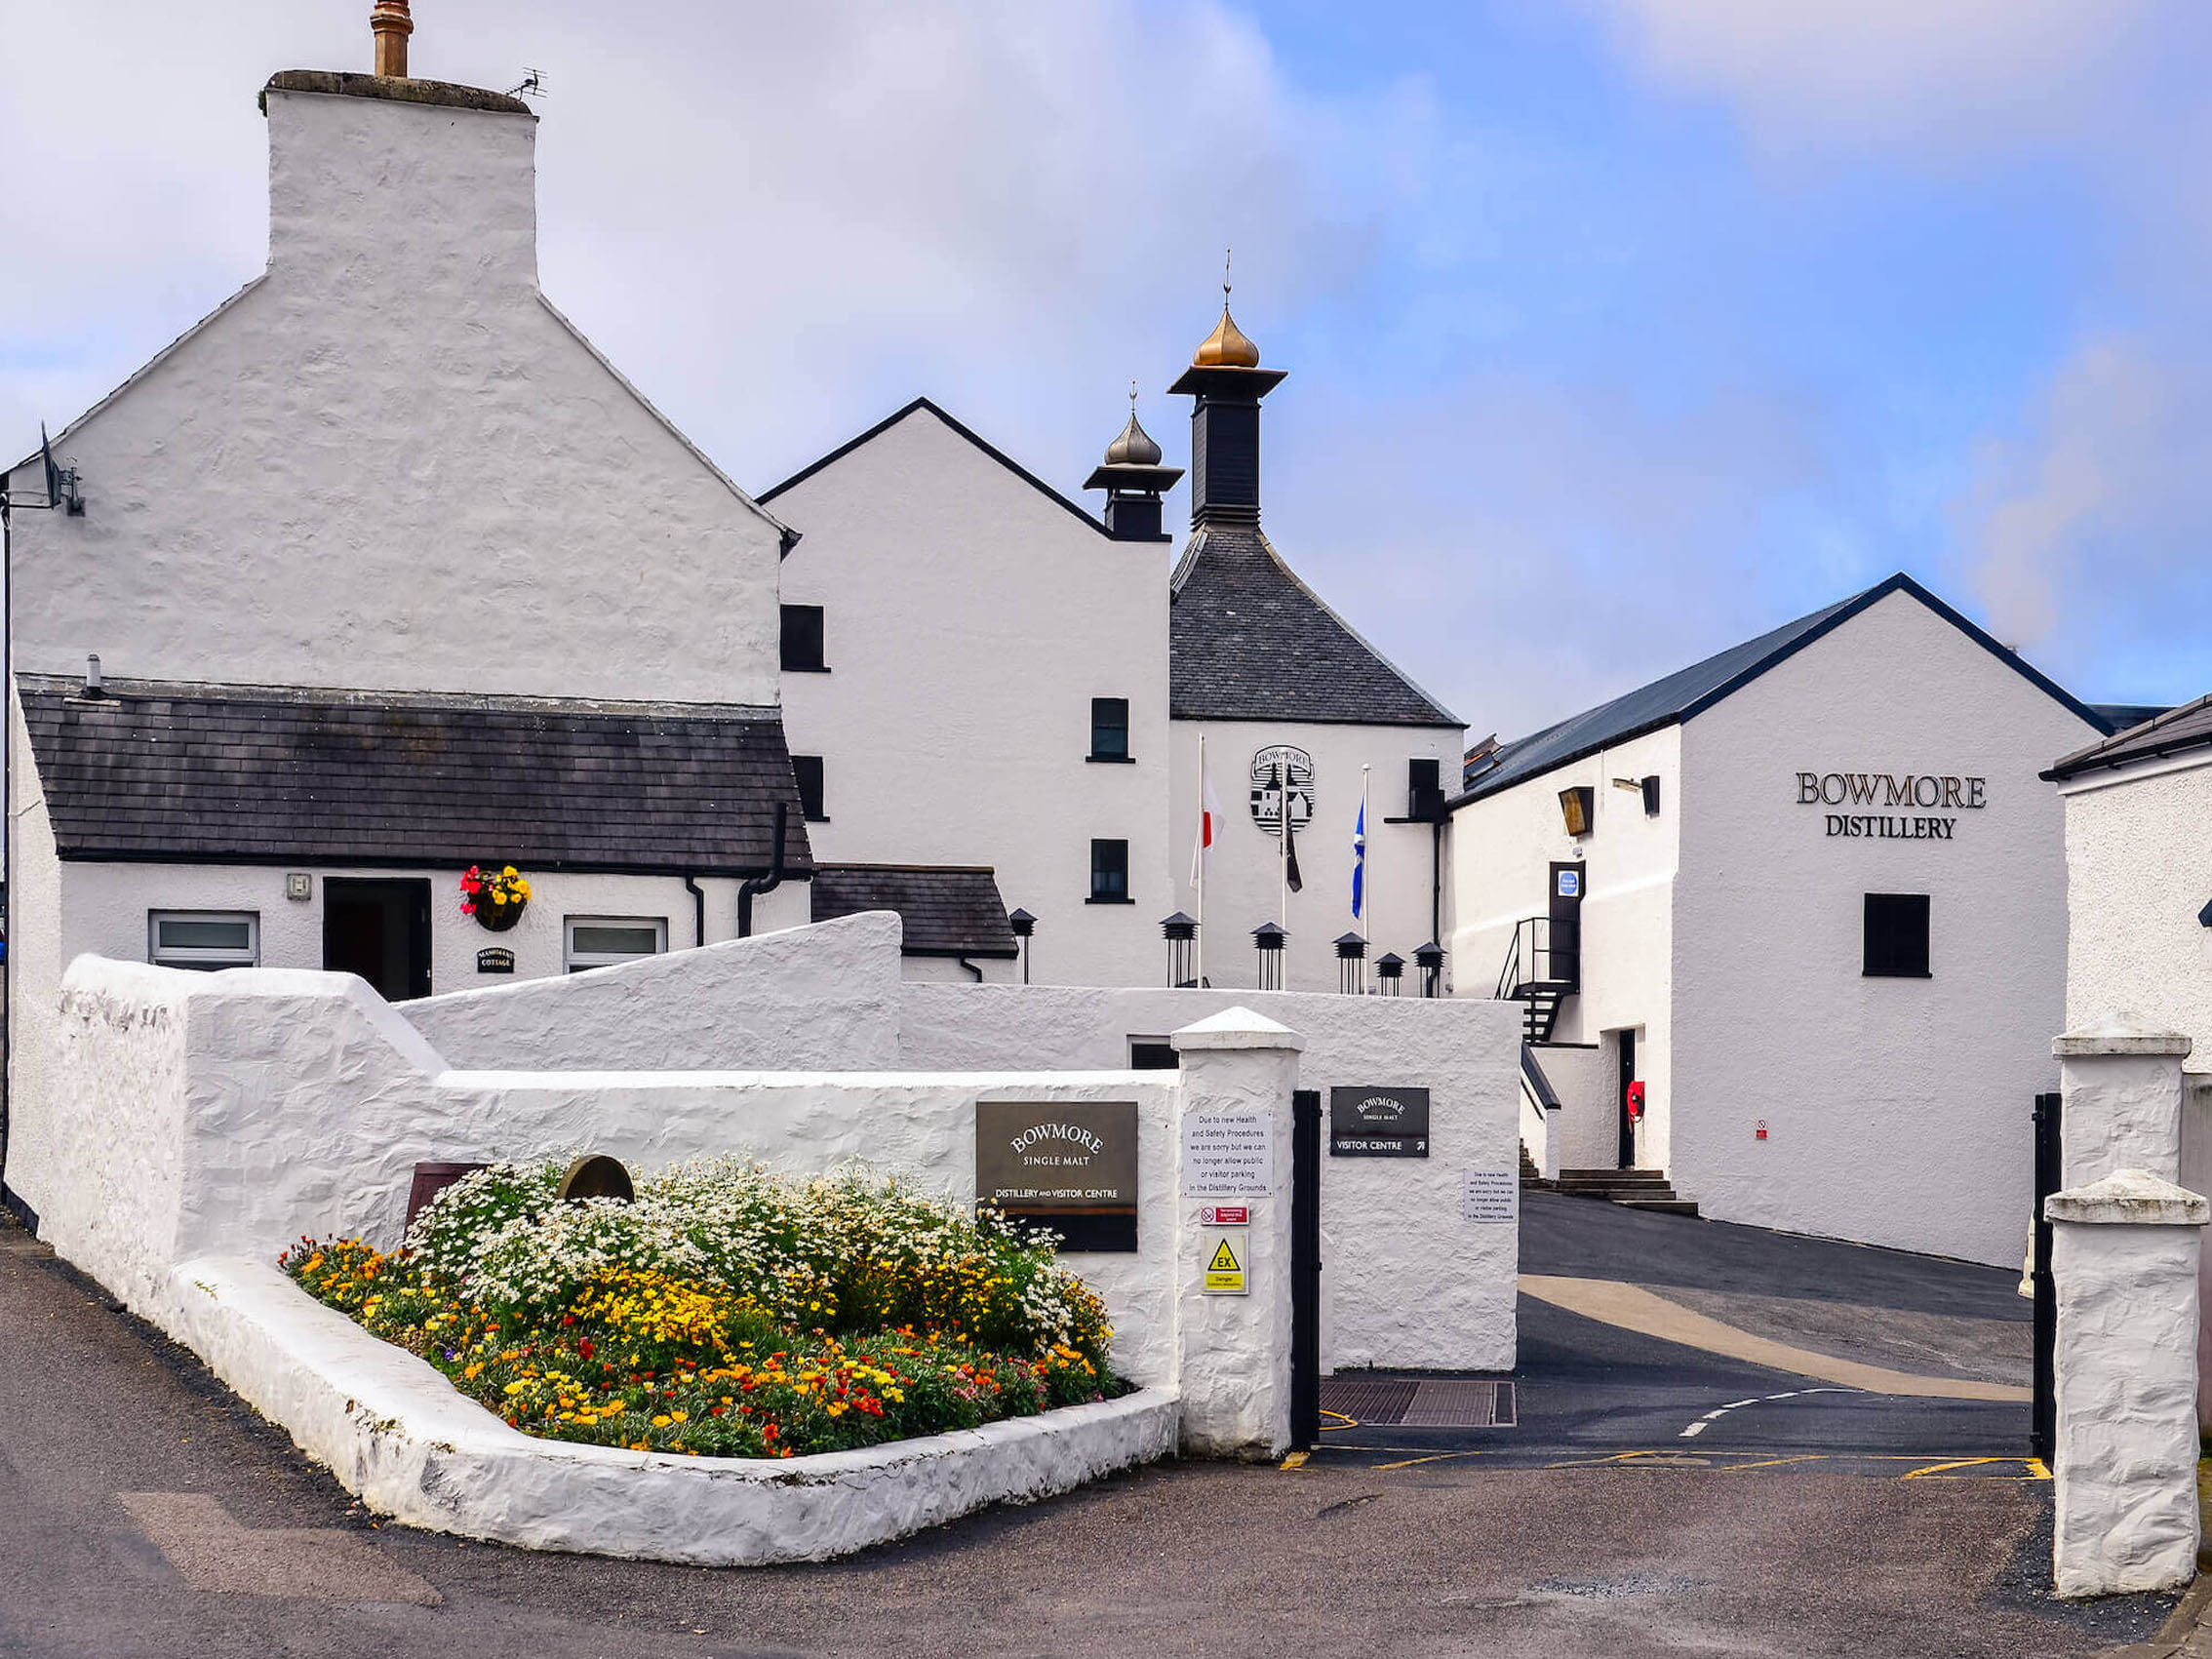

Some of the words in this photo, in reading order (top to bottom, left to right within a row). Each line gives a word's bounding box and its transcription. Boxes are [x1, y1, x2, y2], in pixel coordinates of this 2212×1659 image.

[1258, 751, 1307, 765] BOWORE
[1796, 772, 1987, 809] BOWMORE
[1824, 814, 1957, 840] DISTILLERY
[1357, 1096, 1405, 1115] BOWMORE
[1009, 1123, 1105, 1155] BOWMORE
[1205, 1129, 1225, 1138] Safety
[1227, 1129, 1264, 1138] Procedures
[1336, 1141, 1367, 1150] VISITOR
[1369, 1141, 1402, 1151] CENTRE
[1023, 1156, 1060, 1166] SINGLE
[1062, 1156, 1090, 1166] MALT
[1208, 1183, 1237, 1193] Distillery
[995, 1189, 1038, 1199] DISTILLERY
[1051, 1189, 1083, 1199] VISITOR
[1085, 1189, 1118, 1199] CENTRE
[1217, 1257, 1231, 1268] EX
